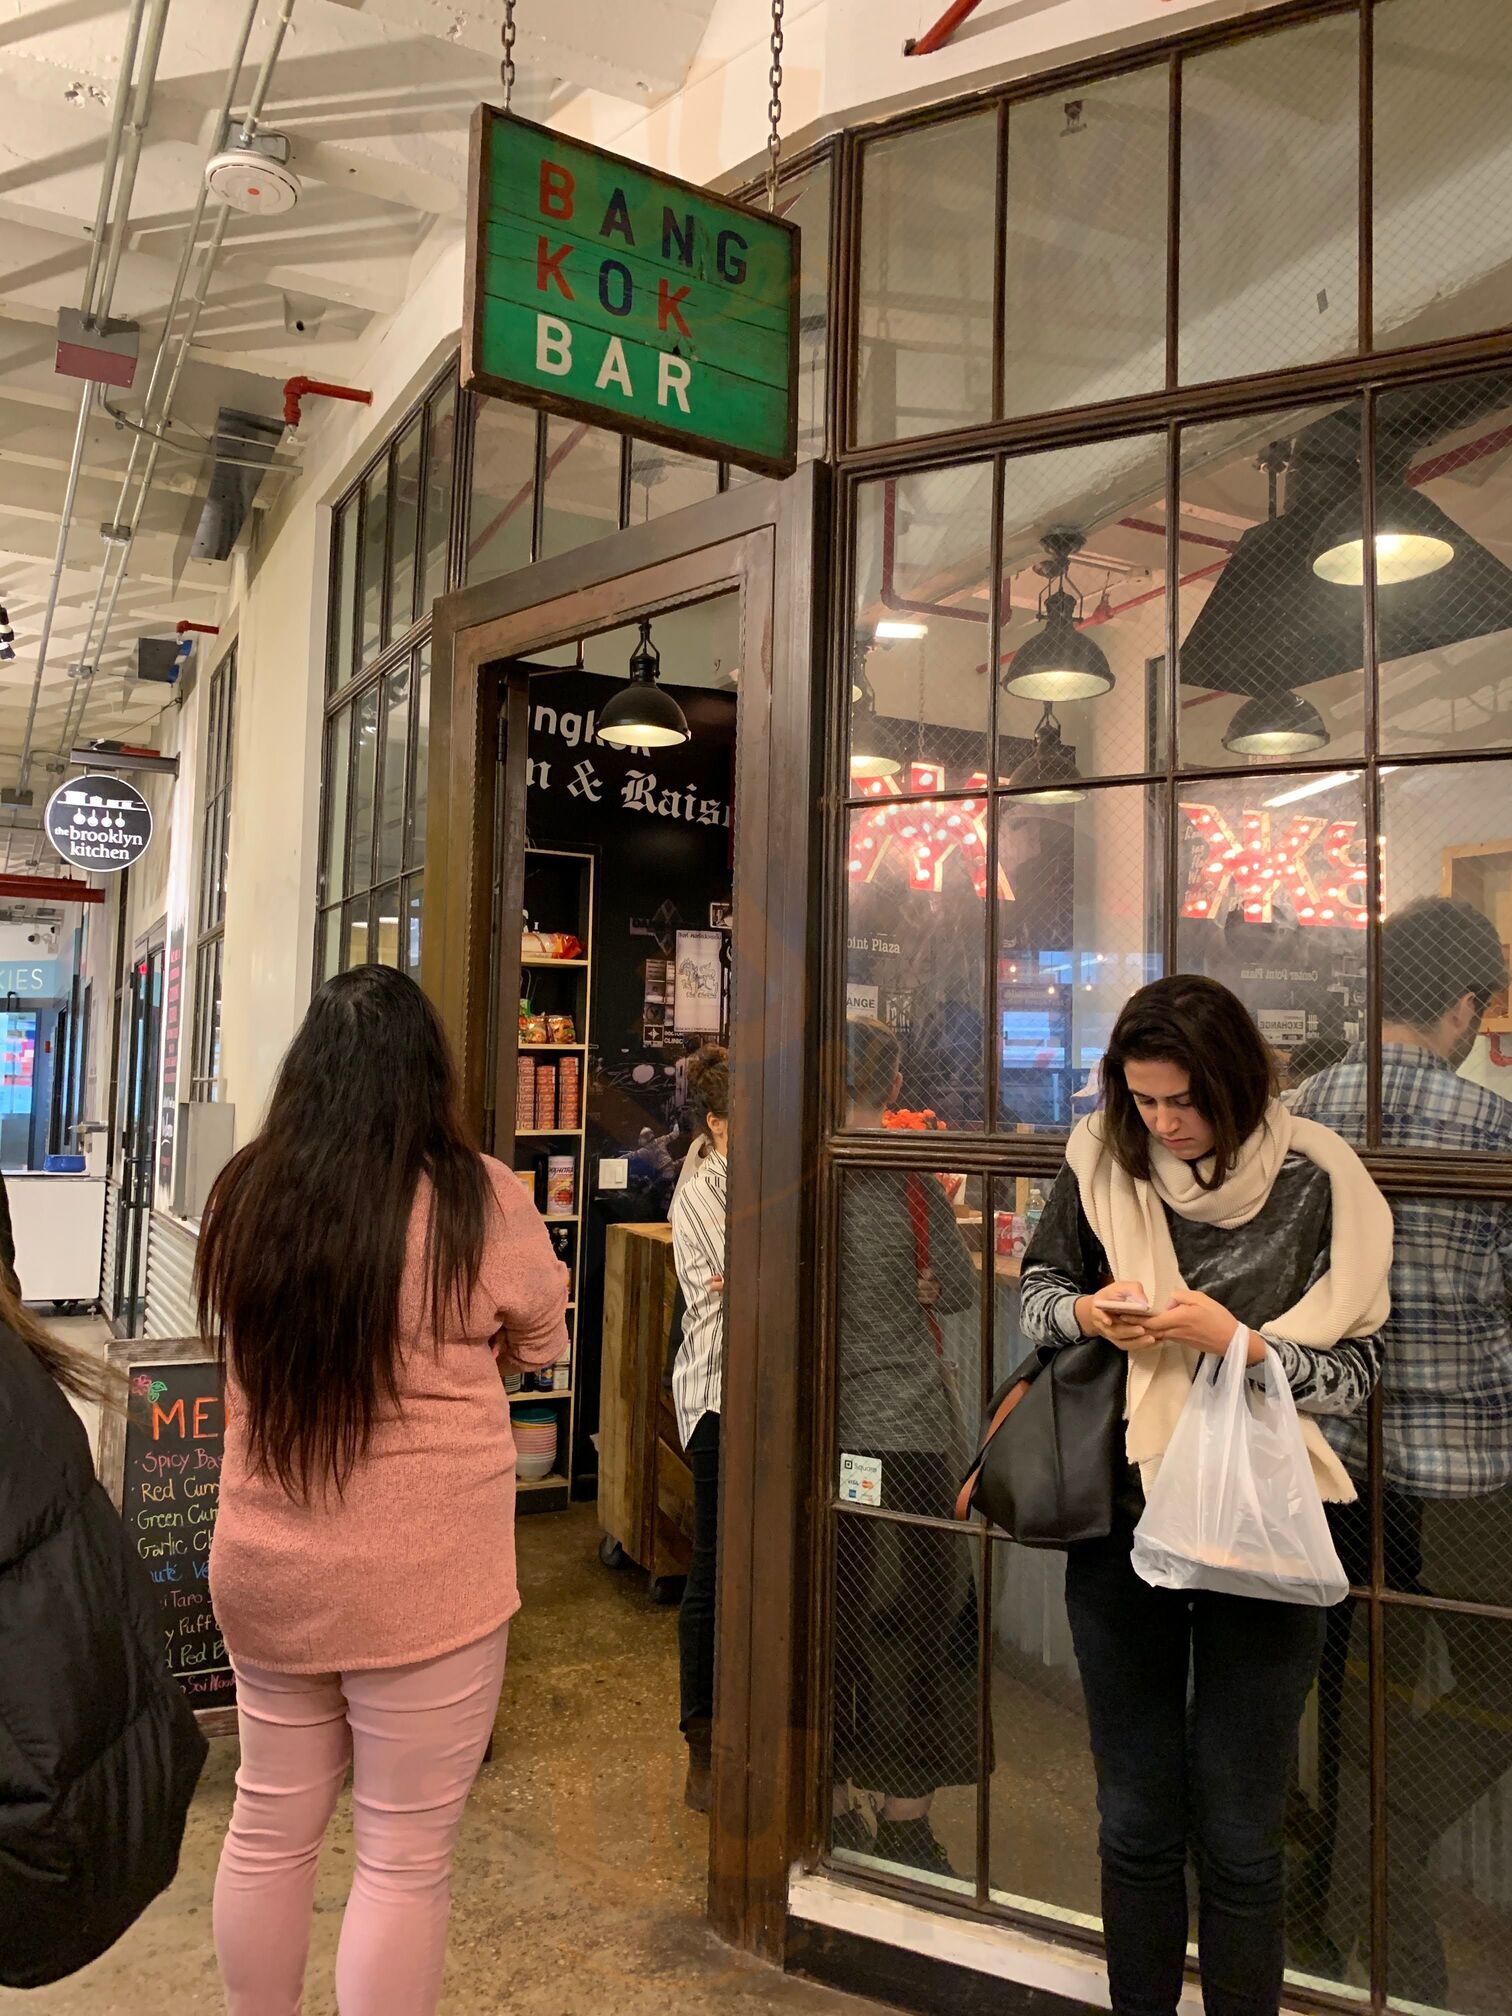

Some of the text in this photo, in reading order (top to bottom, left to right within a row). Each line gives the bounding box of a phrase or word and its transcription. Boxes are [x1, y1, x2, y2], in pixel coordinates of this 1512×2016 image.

[539, 160, 748, 285] BANG
[536, 234, 693, 339] KOK
[535, 313, 692, 414] BAR
[566, 759, 602, 803] &
[621, 769, 730, 828] Rais
[54, 825, 143, 848] the brooklyn
[70, 841, 130, 860] kitchen
[871, 938, 901, 954] Plaza
[142, 1450, 190, 1478] Spicy
[141, 1478, 176, 1503] Red
[137, 1509, 184, 1530] Green
[137, 1532, 188, 1559] Garlic
[170, 1590, 203, 1608] Taro
[179, 1614, 212, 1636] Puff
